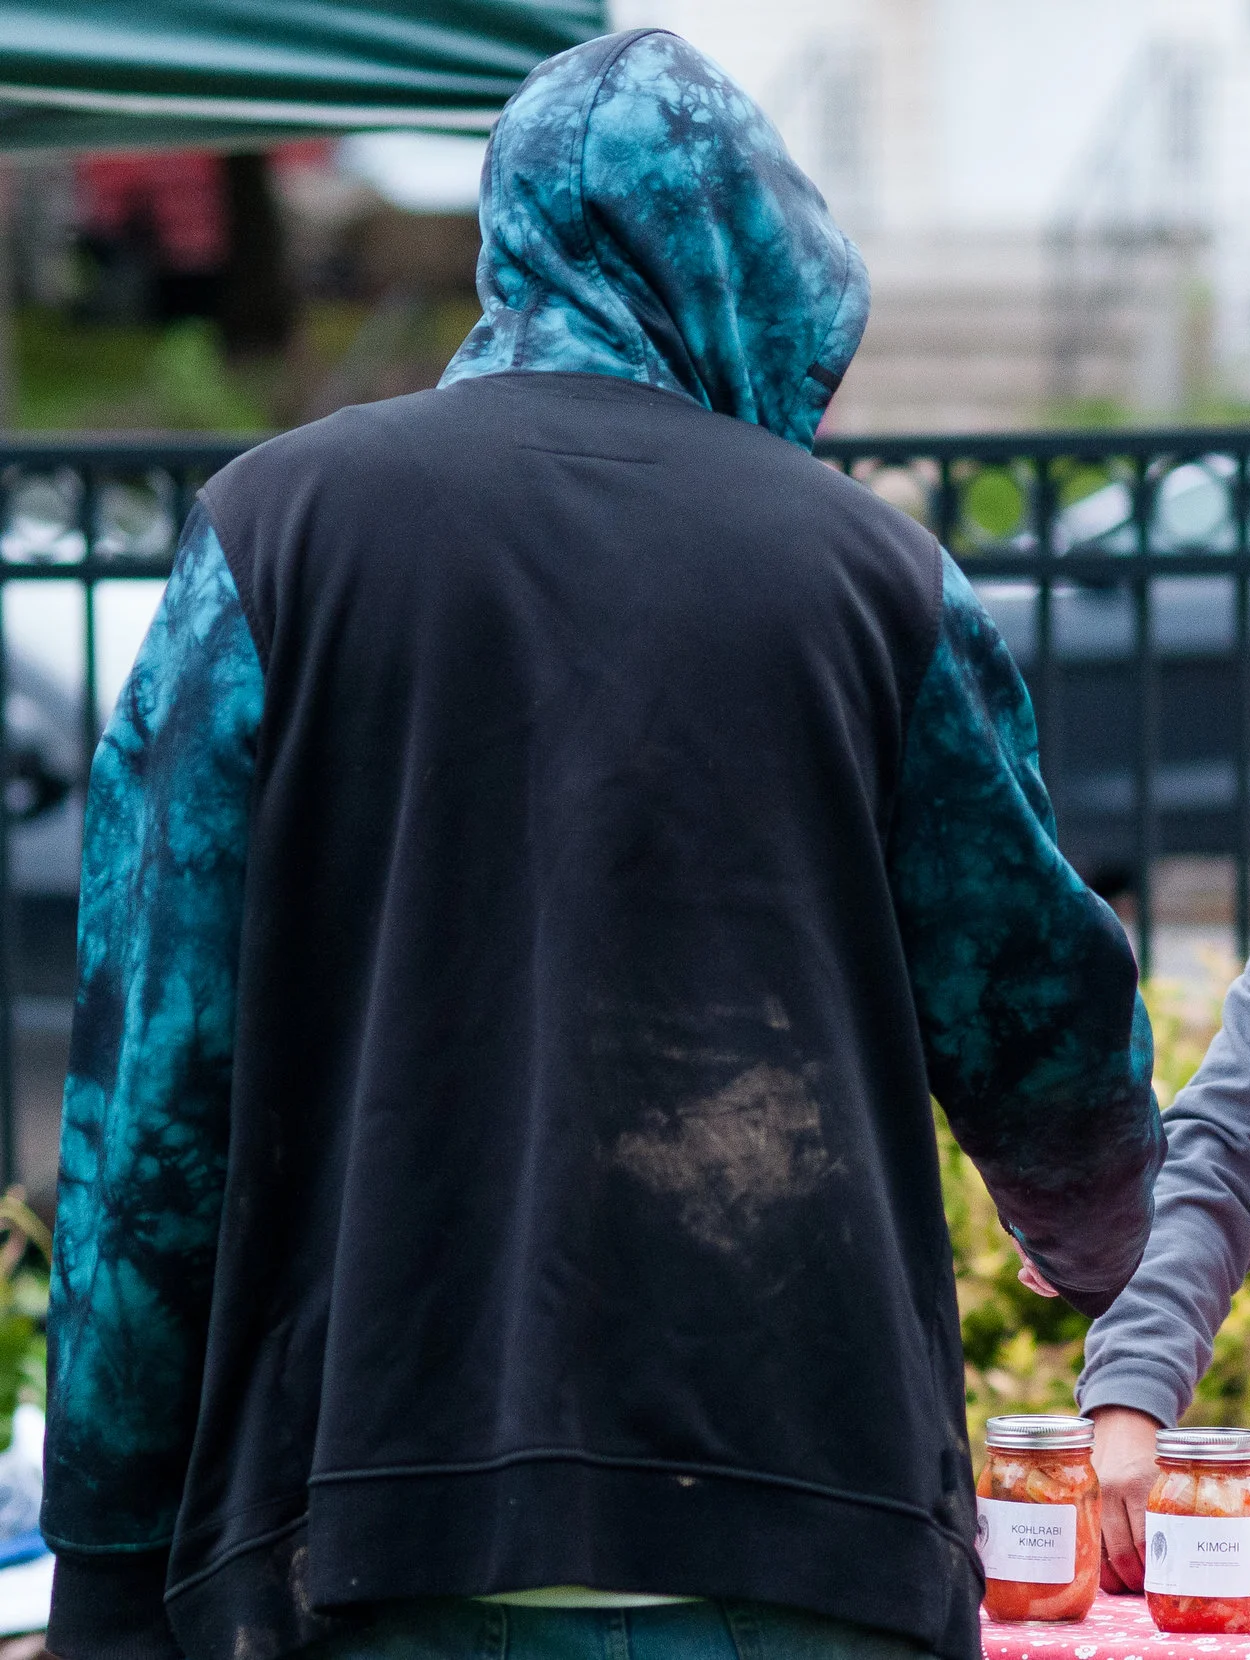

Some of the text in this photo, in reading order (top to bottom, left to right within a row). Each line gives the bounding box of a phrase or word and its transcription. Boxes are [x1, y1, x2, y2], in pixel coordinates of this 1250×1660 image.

[1011, 1525, 1062, 1536] KOHLRABI
[1019, 1537, 1055, 1548] KIMCHI
[1197, 1541, 1240, 1553] KIMCHI
